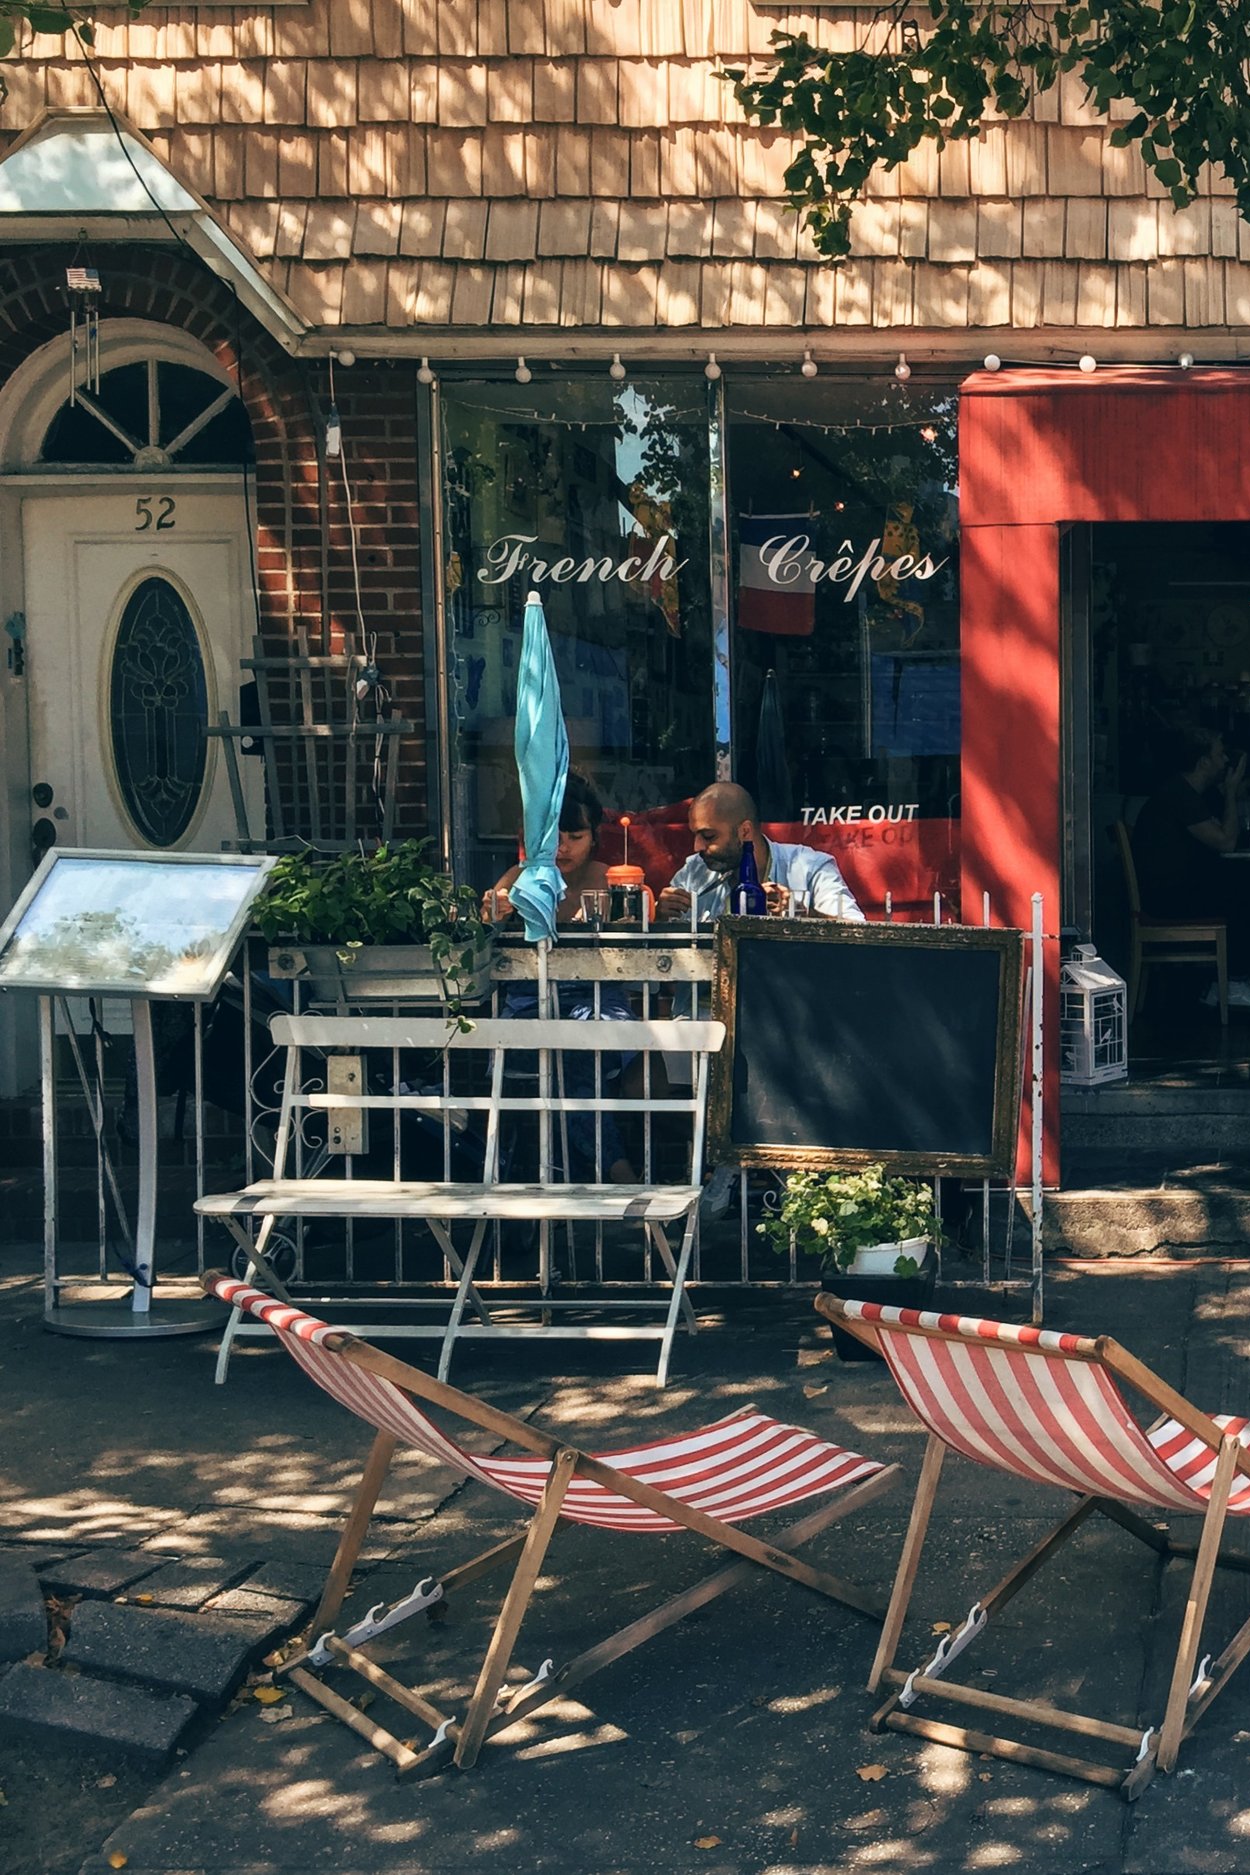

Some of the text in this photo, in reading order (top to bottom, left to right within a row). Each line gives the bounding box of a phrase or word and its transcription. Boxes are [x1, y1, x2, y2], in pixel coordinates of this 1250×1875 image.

[135, 496, 176, 531] 52
[477, 534, 951, 602] French Crêpes
[800, 804, 919, 826] TAKE OUT
